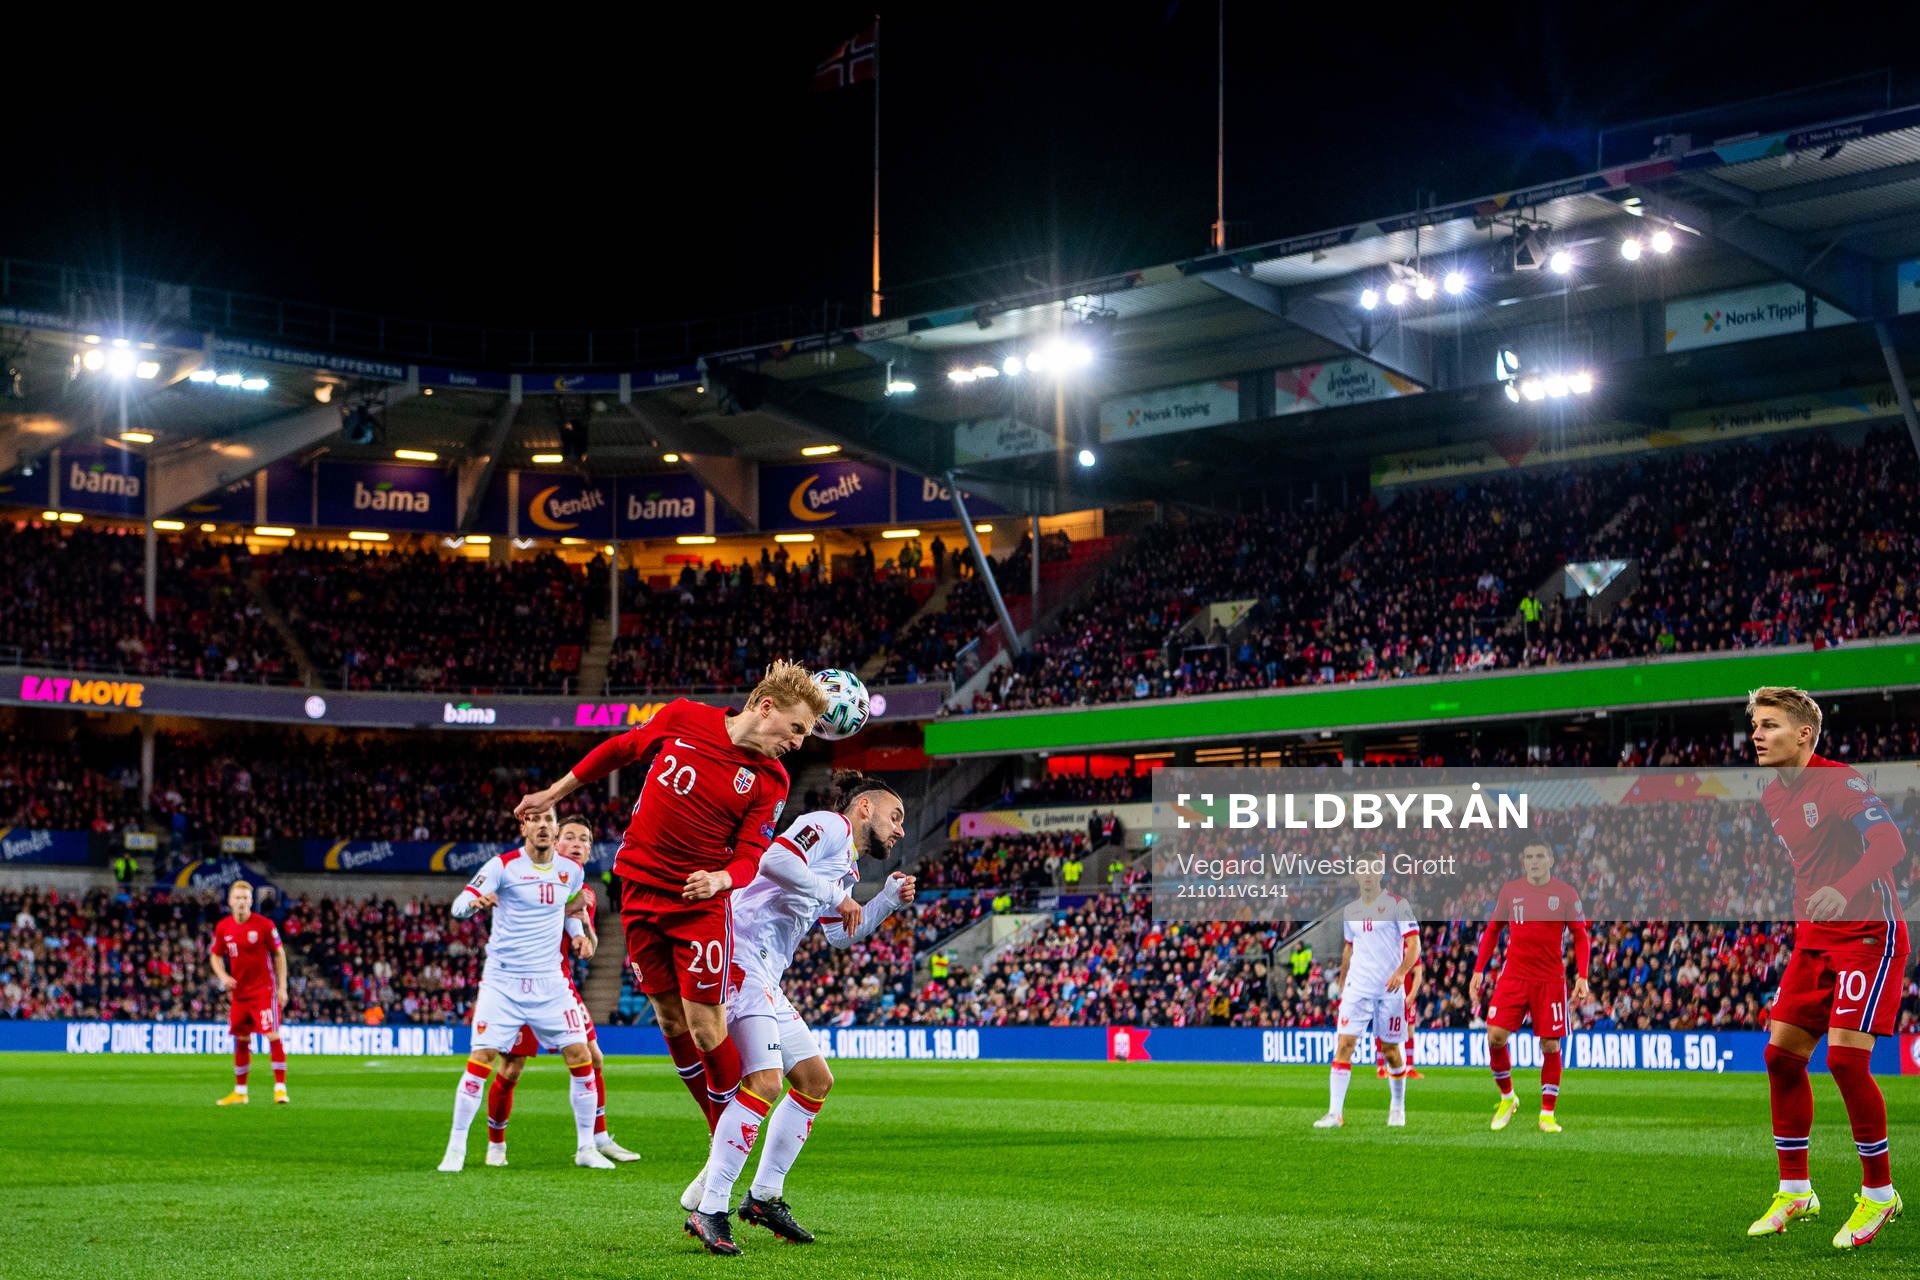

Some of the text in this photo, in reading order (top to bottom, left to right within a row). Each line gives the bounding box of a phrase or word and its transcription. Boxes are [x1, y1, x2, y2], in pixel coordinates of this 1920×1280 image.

[1726, 310, 1765, 326] Norsk
[1143, 402, 1211, 422] Norsk Tipping
[1730, 406, 1812, 427] Norsk Tipping
[70, 461, 141, 498] bama
[808, 471, 863, 510] Bendit
[353, 481, 431, 513] bama
[550, 487, 606, 520] Bendit
[627, 494, 696, 521] bama
[444, 702, 497, 725] bama
[657, 754, 697, 796] 20
[1864, 807, 1883, 821] C
[1, 829, 52, 860] Bendit
[341, 840, 394, 870] Bendit
[539, 883, 554, 905] 10
[1362, 918, 1373, 932] 18
[1513, 905, 1524, 925] 11
[687, 940, 723, 974] 20
[1837, 970, 1867, 1001] 10
[563, 1009, 580, 1028] 10
[1389, 1016, 1402, 1032] 18
[1551, 1002, 1563, 1022] 11
[111, 1024, 152, 1053] DINE
[152, 1024, 236, 1054] BILLETTER
[260, 1025, 425, 1056] TCKETMASTER.NO
[837, 1029, 906, 1058] OKTOBER
[908, 1029, 934, 1058] KL.
[933, 1029, 979, 1059] 19.00
[1576, 1034, 1636, 1068] BARN
[1642, 1034, 1681, 1069] KR.
[1685, 1035, 1734, 1074] 50,-
